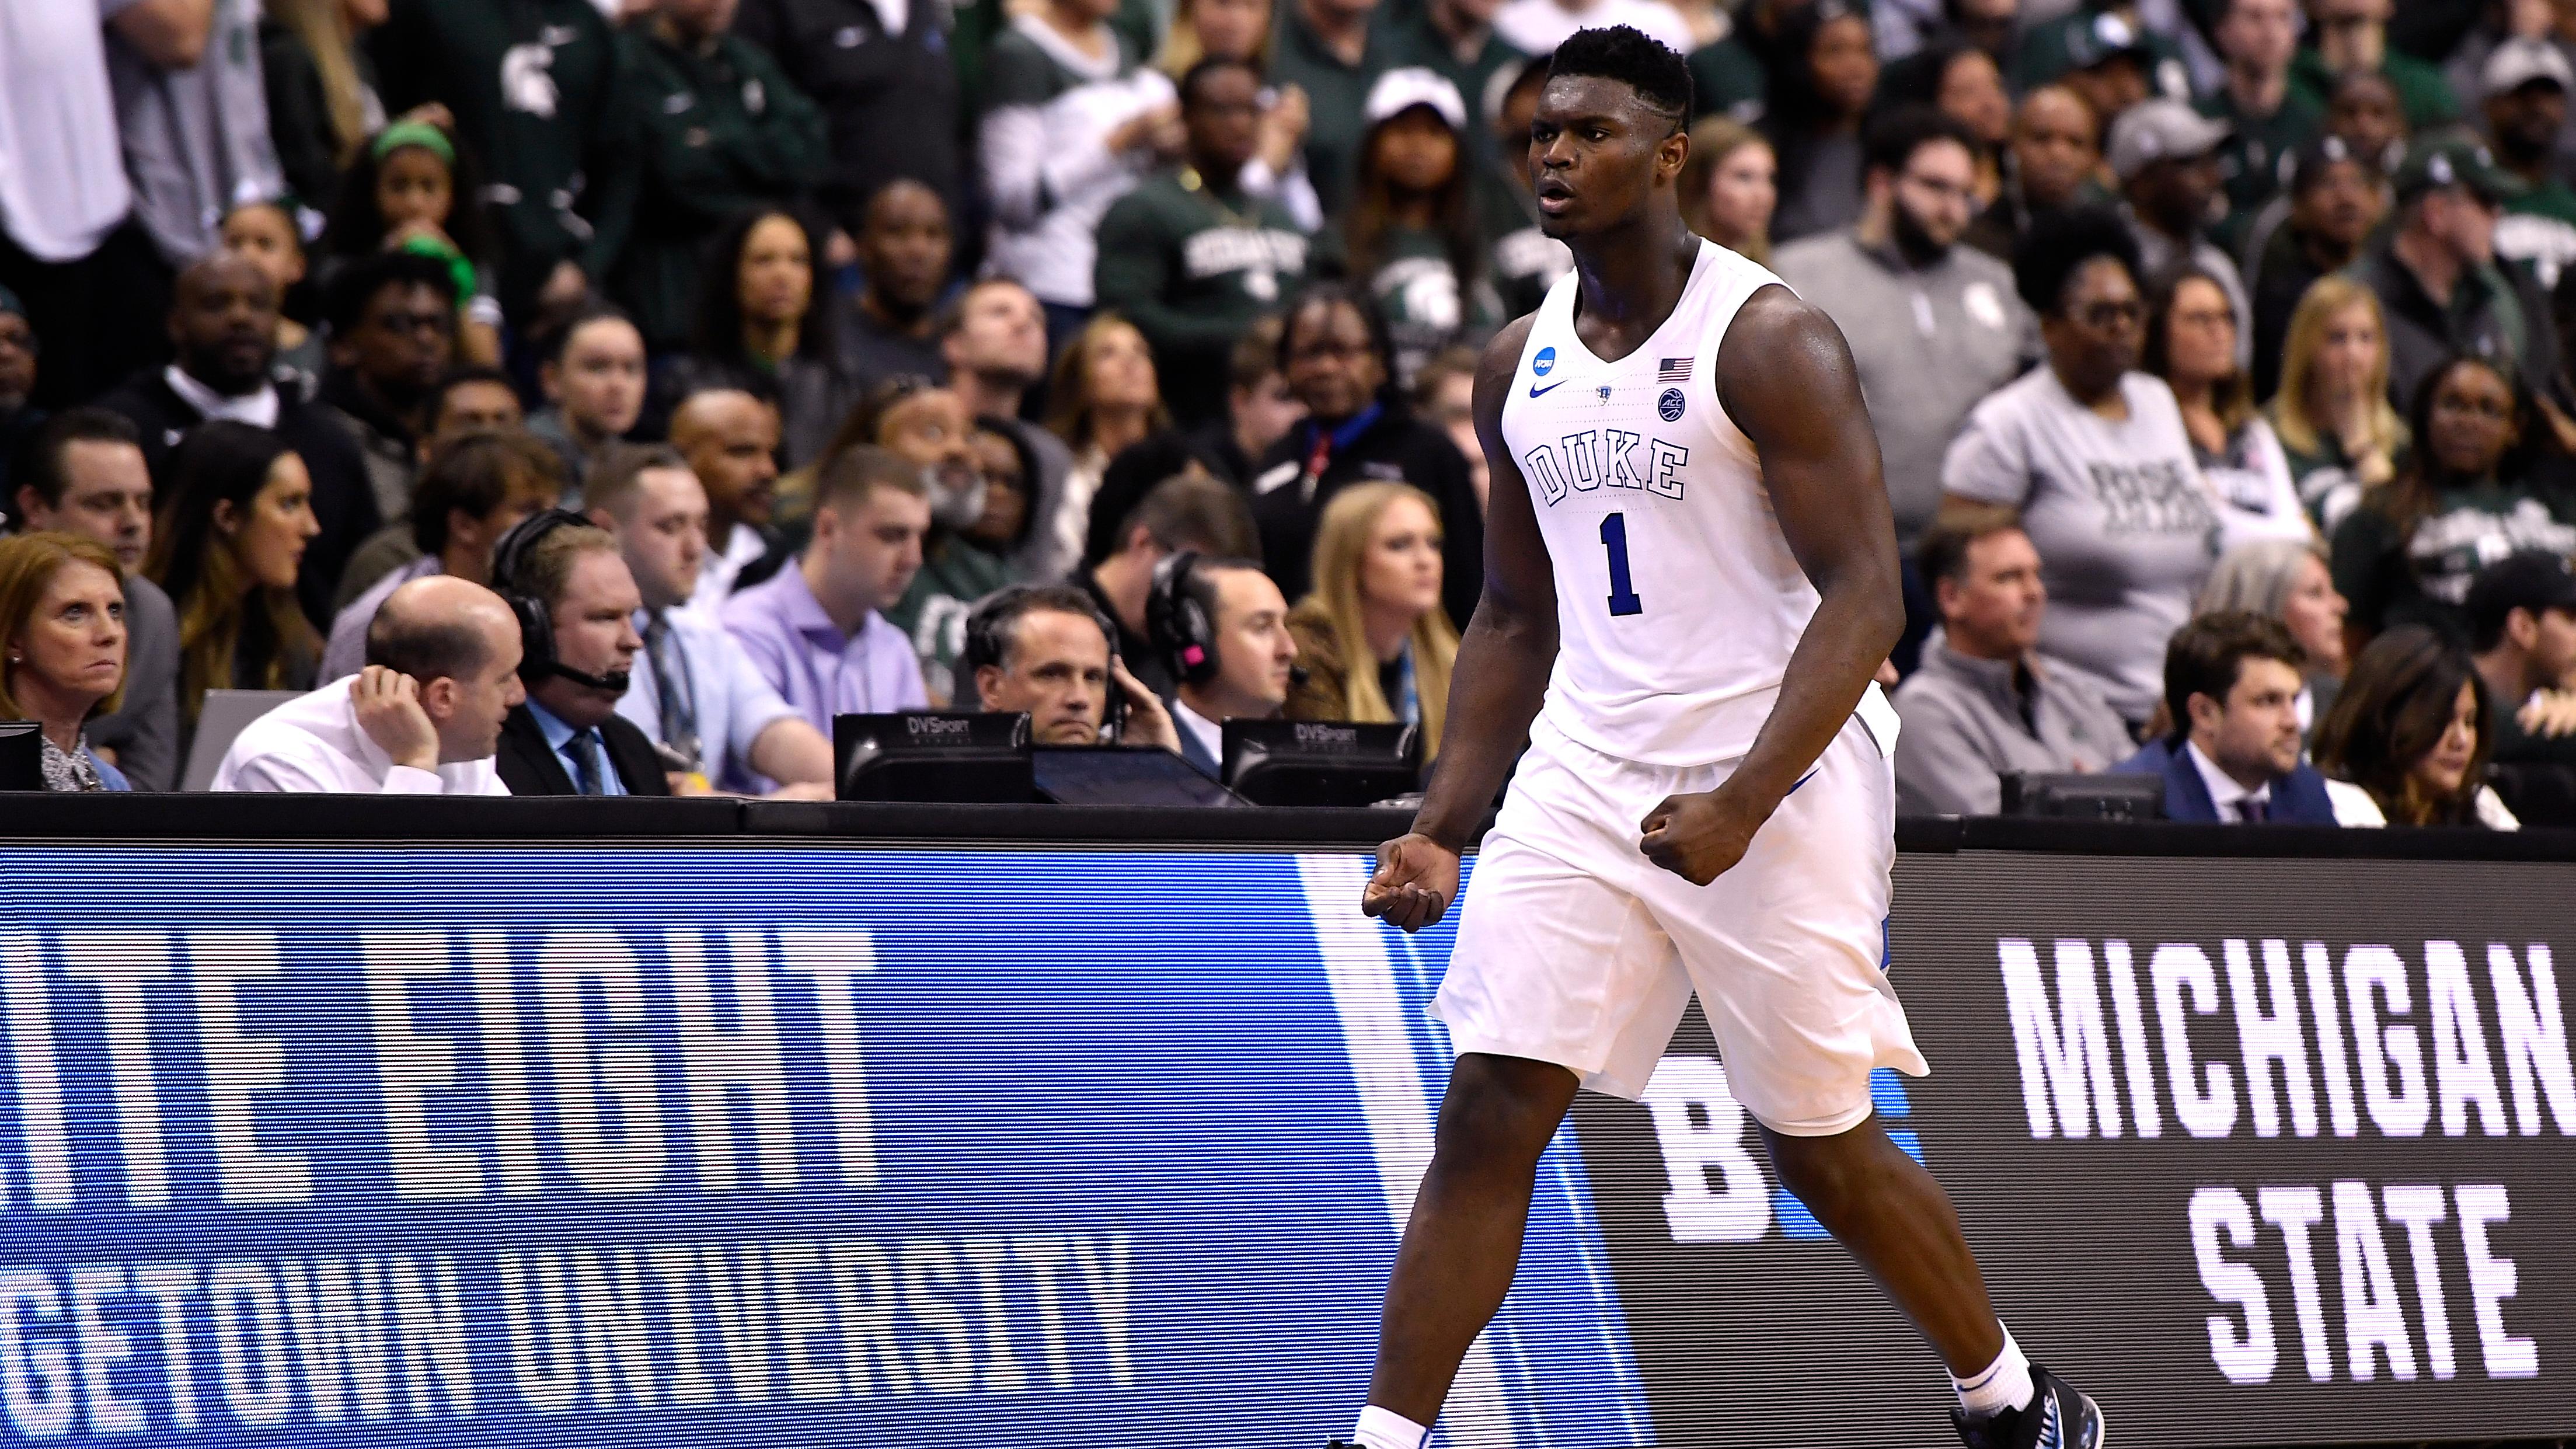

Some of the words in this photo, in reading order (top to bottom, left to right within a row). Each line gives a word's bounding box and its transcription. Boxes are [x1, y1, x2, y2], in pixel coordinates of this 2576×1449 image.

[1525, 429, 1689, 507] DUKE
[1662, 399, 1682, 407] ACC
[1599, 512, 1643, 616] 1
[0, 927, 313, 1210] ITE
[358, 926, 881, 1200] EIGHT
[1997, 937, 2576, 1140] MICHIGAN
[496, 1229, 1136, 1415] UNIVERSITY
[2188, 1177, 2539, 1384] STATE
